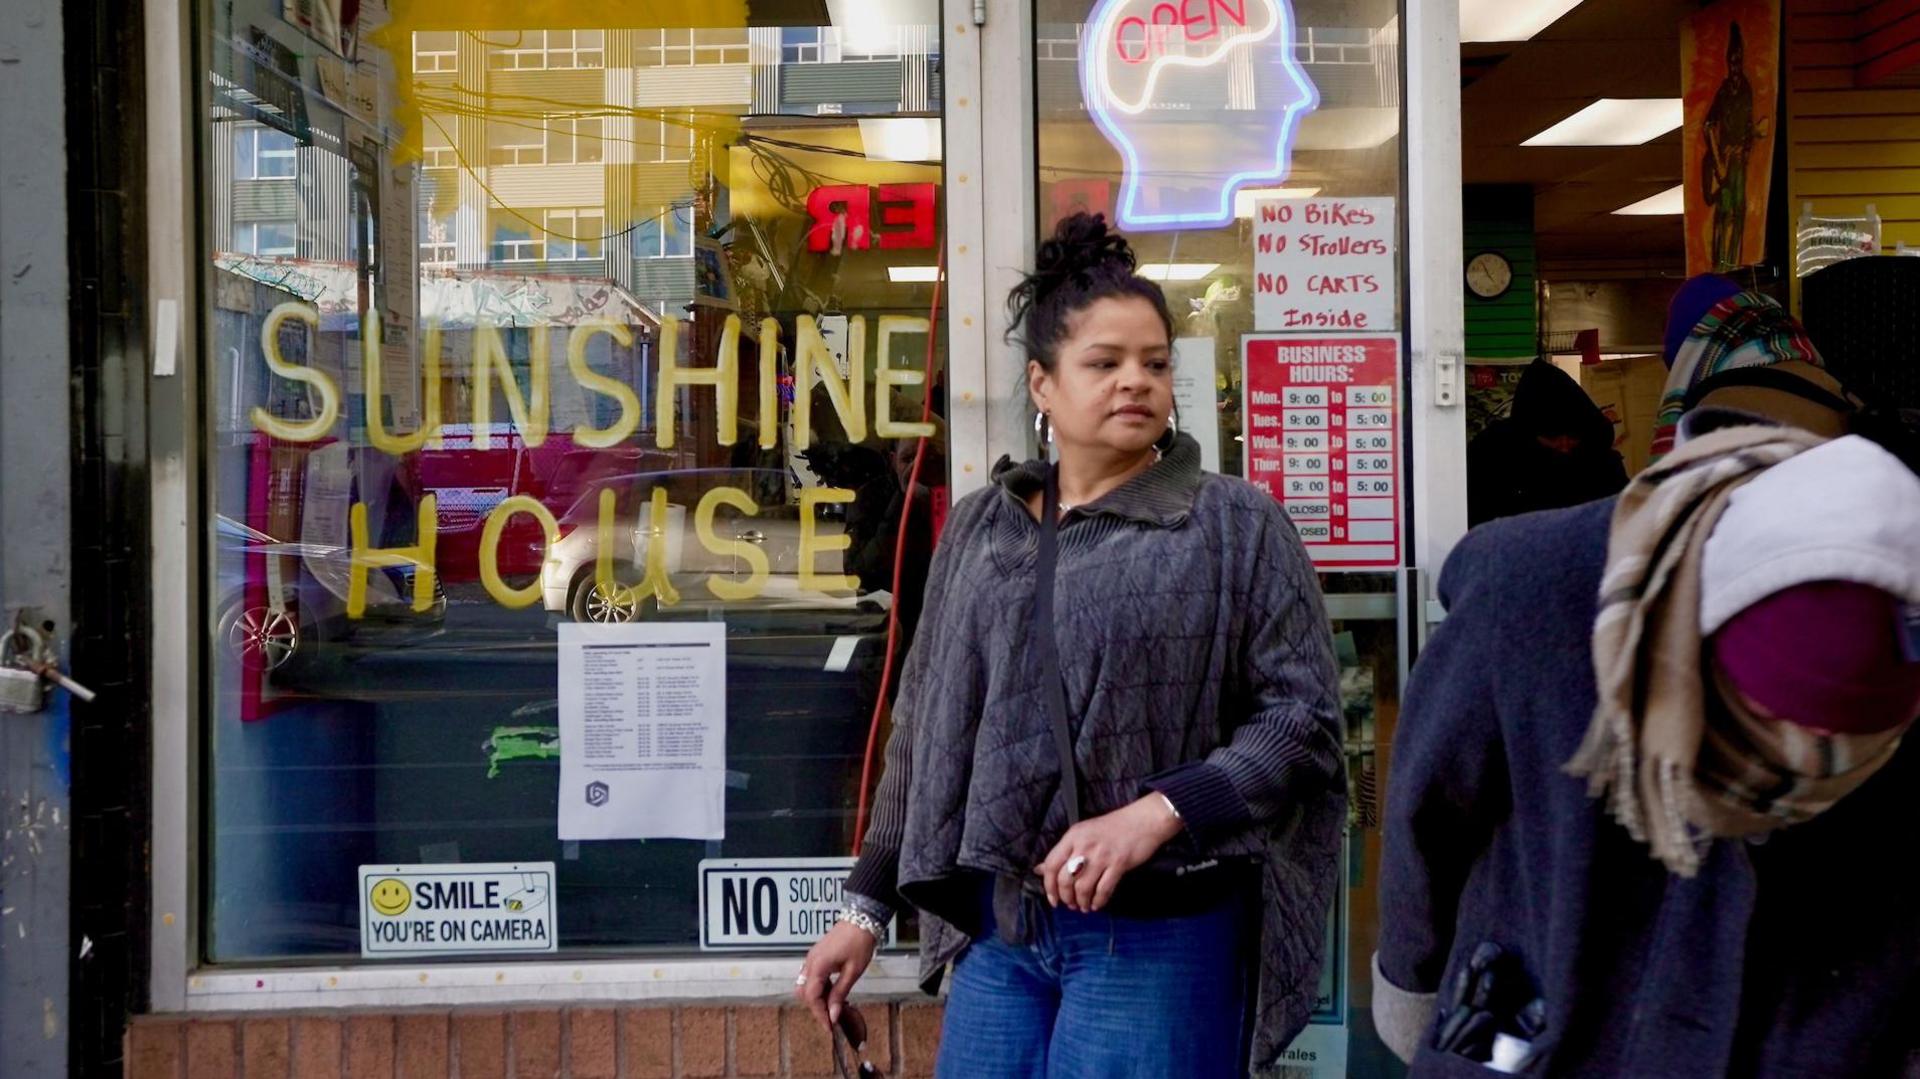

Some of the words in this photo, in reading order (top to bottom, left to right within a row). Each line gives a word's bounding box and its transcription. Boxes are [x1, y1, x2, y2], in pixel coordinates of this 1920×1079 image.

[1116, 0, 1245, 63] OPEN
[1262, 205, 1292, 223] NO
[1258, 233, 1286, 254] NO
[1258, 272, 1288, 295] NO
[1307, 274, 1379, 295] CARTS
[1283, 308, 1368, 328] Inside
[1277, 345, 1366, 364] BUSINESS
[251, 302, 936, 454] SUNSHINE
[1289, 365, 1354, 383] HOURS:
[1252, 391, 1281, 404] Mon.
[1331, 391, 1343, 404] to
[1252, 413, 1281, 427] Tues.
[1331, 413, 1343, 426] to
[1252, 435, 1281, 449] Wed.
[1331, 435, 1343, 448] to
[1332, 458, 1343, 470] to
[1332, 480, 1344, 493] to
[1289, 505, 1329, 515] CLOSED
[1300, 527, 1328, 536] OSED
[345, 486, 861, 620] HOUSE
[415, 881, 500, 910] SMILE
[788, 877, 849, 903] SOLICIT
[722, 877, 779, 936] NO
[372, 921, 435, 943] YOU'RE
[440, 920, 466, 942] ON
[471, 918, 547, 941] CAMERA
[789, 909, 842, 935] LOITE
